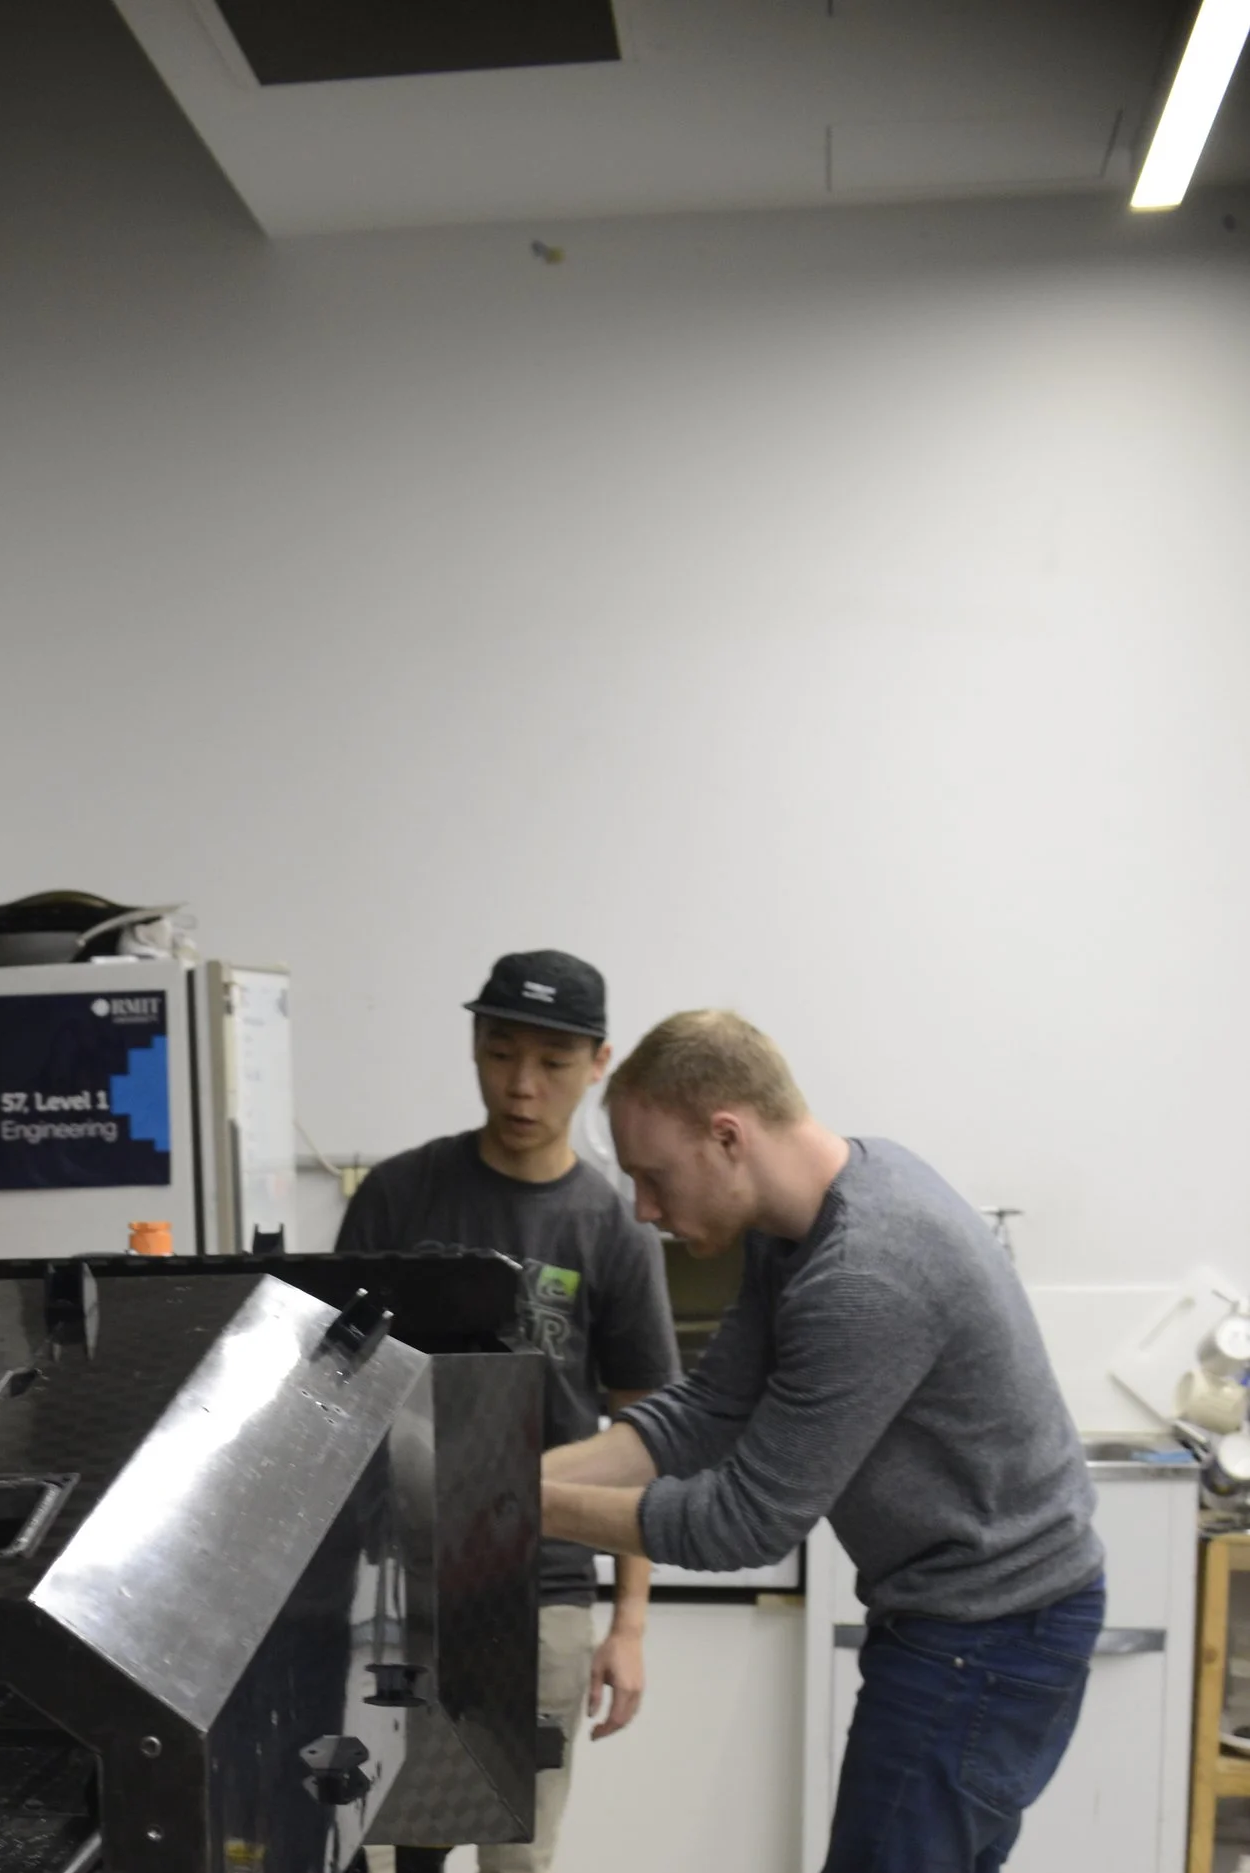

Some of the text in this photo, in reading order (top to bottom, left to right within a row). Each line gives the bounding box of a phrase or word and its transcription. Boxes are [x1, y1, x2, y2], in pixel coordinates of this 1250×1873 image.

[111, 996, 162, 1015] RMIT
[34, 1090, 91, 1112] Level
[96, 1090, 110, 1110] 1
[1, 1120, 118, 1145] Engineering
